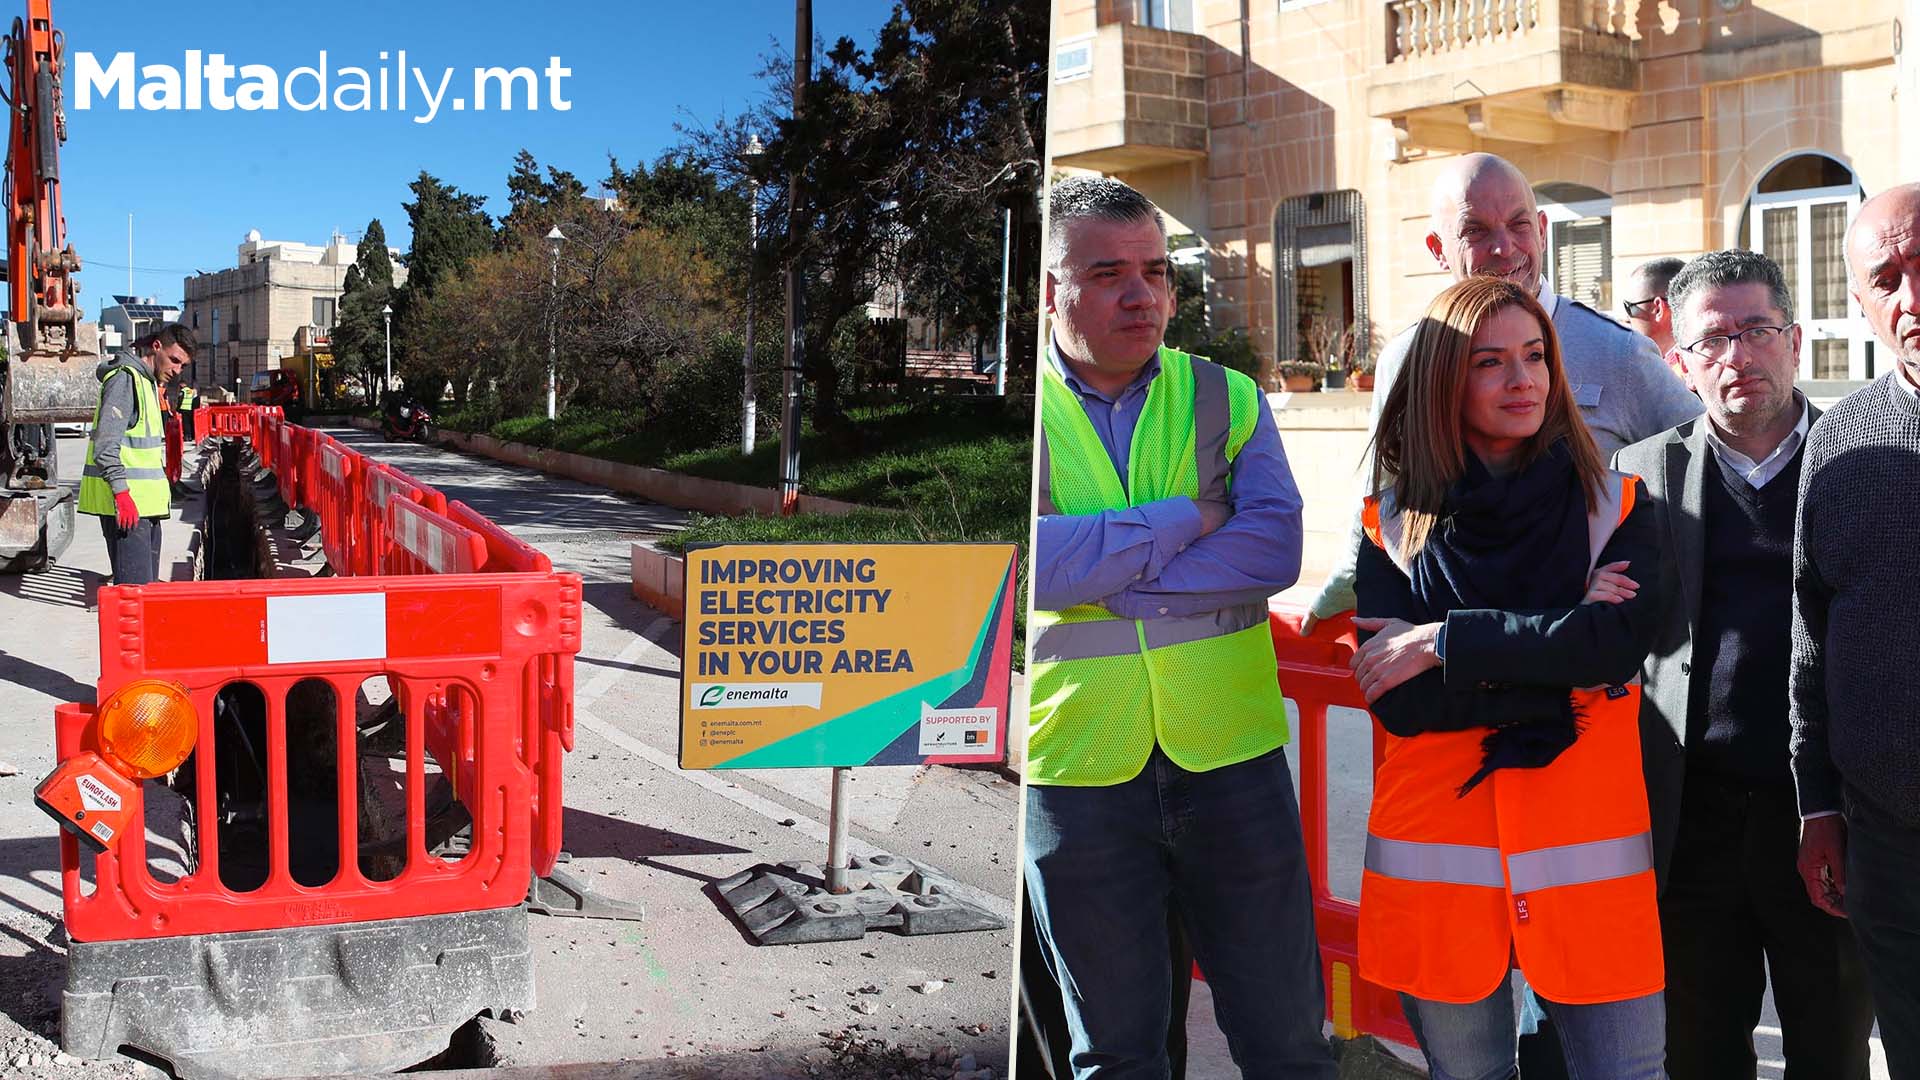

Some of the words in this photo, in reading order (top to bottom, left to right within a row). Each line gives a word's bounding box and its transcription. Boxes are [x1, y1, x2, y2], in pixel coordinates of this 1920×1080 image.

[700, 558, 876, 584] IMPROVING
[700, 588, 893, 615] ELECTRICITY
[699, 619, 846, 646] SERVICES
[699, 651, 729, 676] IN
[739, 649, 824, 675] YOUR
[831, 648, 914, 673] AREA
[726, 687, 789, 701] enemalta
[926, 715, 978, 725] SUPPORTED
[979, 715, 992, 723] BY
[709, 738, 744, 746] @enemalta
[81, 778, 118, 808] EUROFLASH
[1517, 899, 1529, 919] LFS
